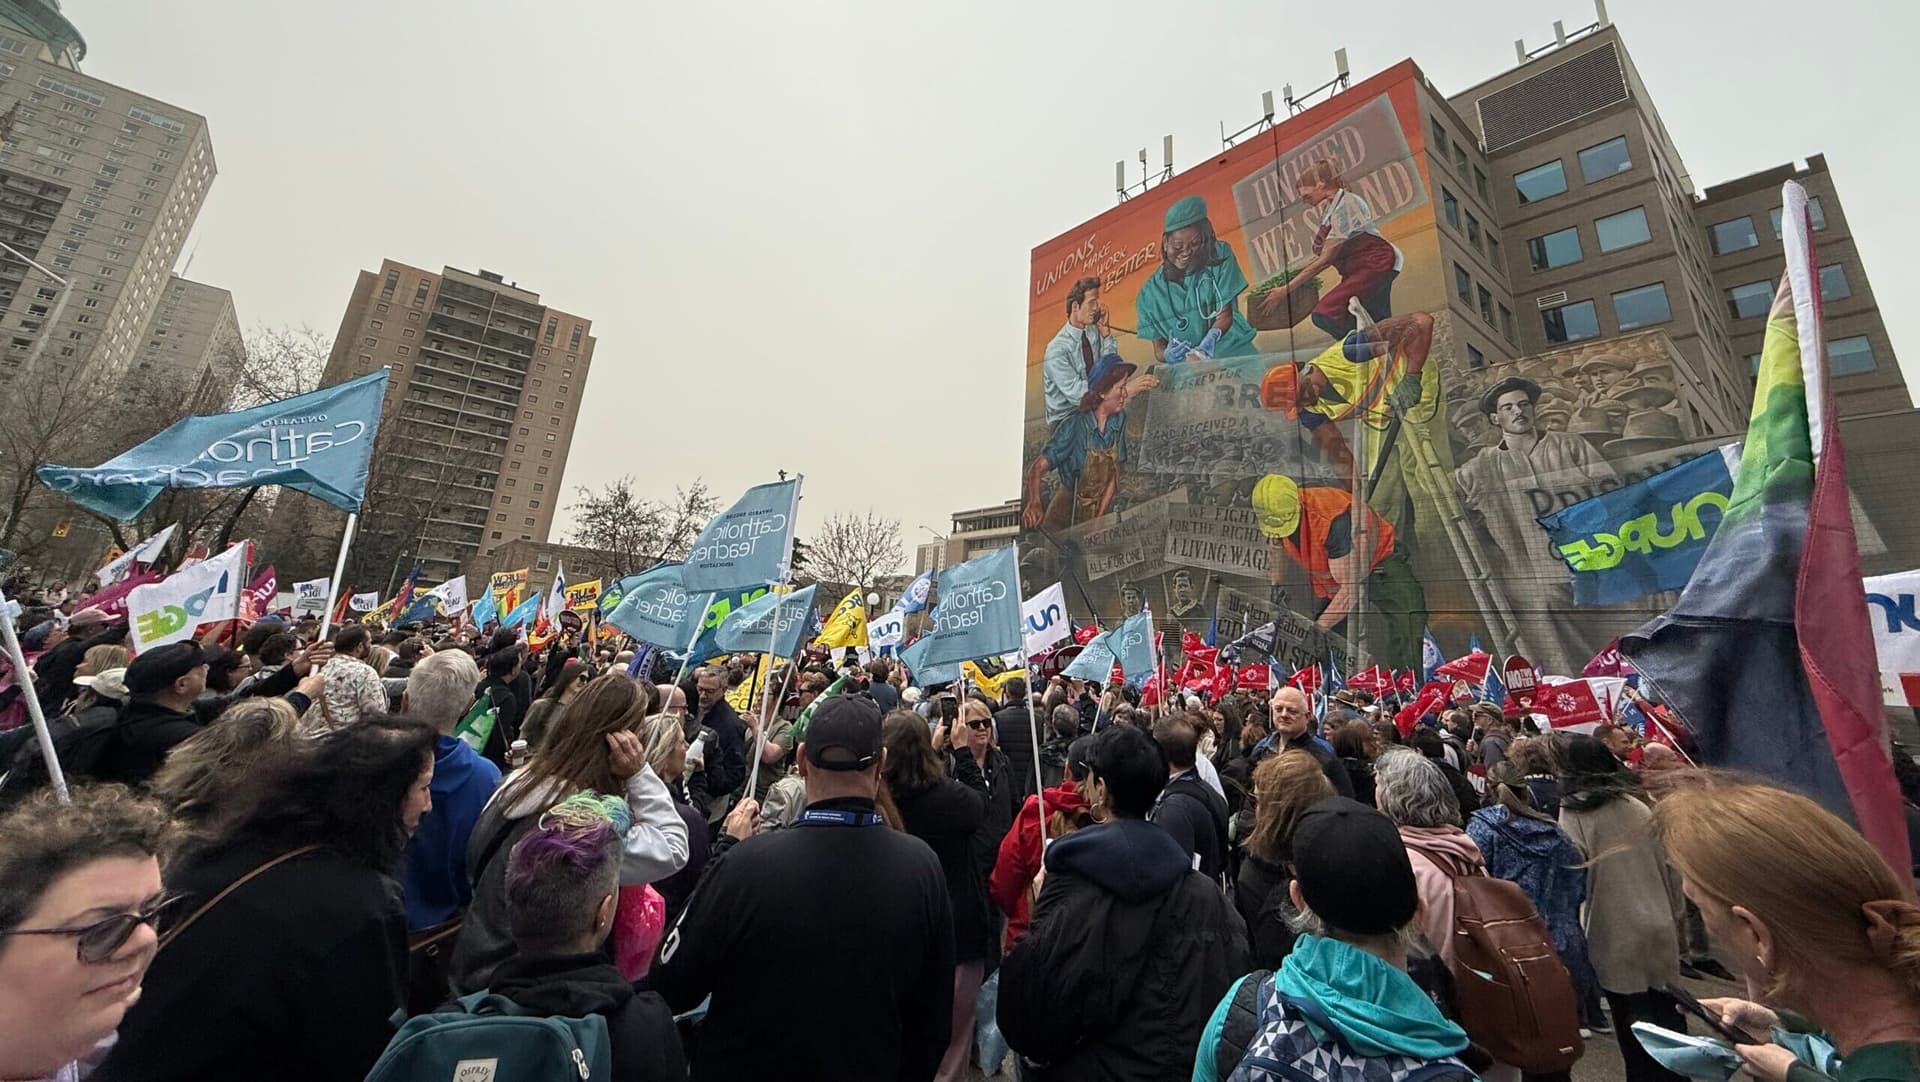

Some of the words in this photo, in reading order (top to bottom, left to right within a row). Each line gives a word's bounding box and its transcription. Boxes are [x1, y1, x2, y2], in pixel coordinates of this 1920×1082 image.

[1251, 126, 1366, 217] UNITED
[1252, 218, 1303, 275] WE
[1303, 161, 1414, 244] STAND
[1036, 233, 1097, 295] UNIONS
[1083, 240, 1112, 272] MAKE
[1097, 245, 1128, 275] WORK
[1104, 241, 1156, 293] BETTER
[1181, 417, 1237, 438] RECEIVED
[1169, 518, 1190, 533] FOR
[1188, 507, 1208, 520] WE
[1215, 507, 1257, 524] FIGHT
[1171, 538, 1179, 555] A
[1181, 539, 1227, 564] LIVING
[1506, 670, 1522, 690] NO
